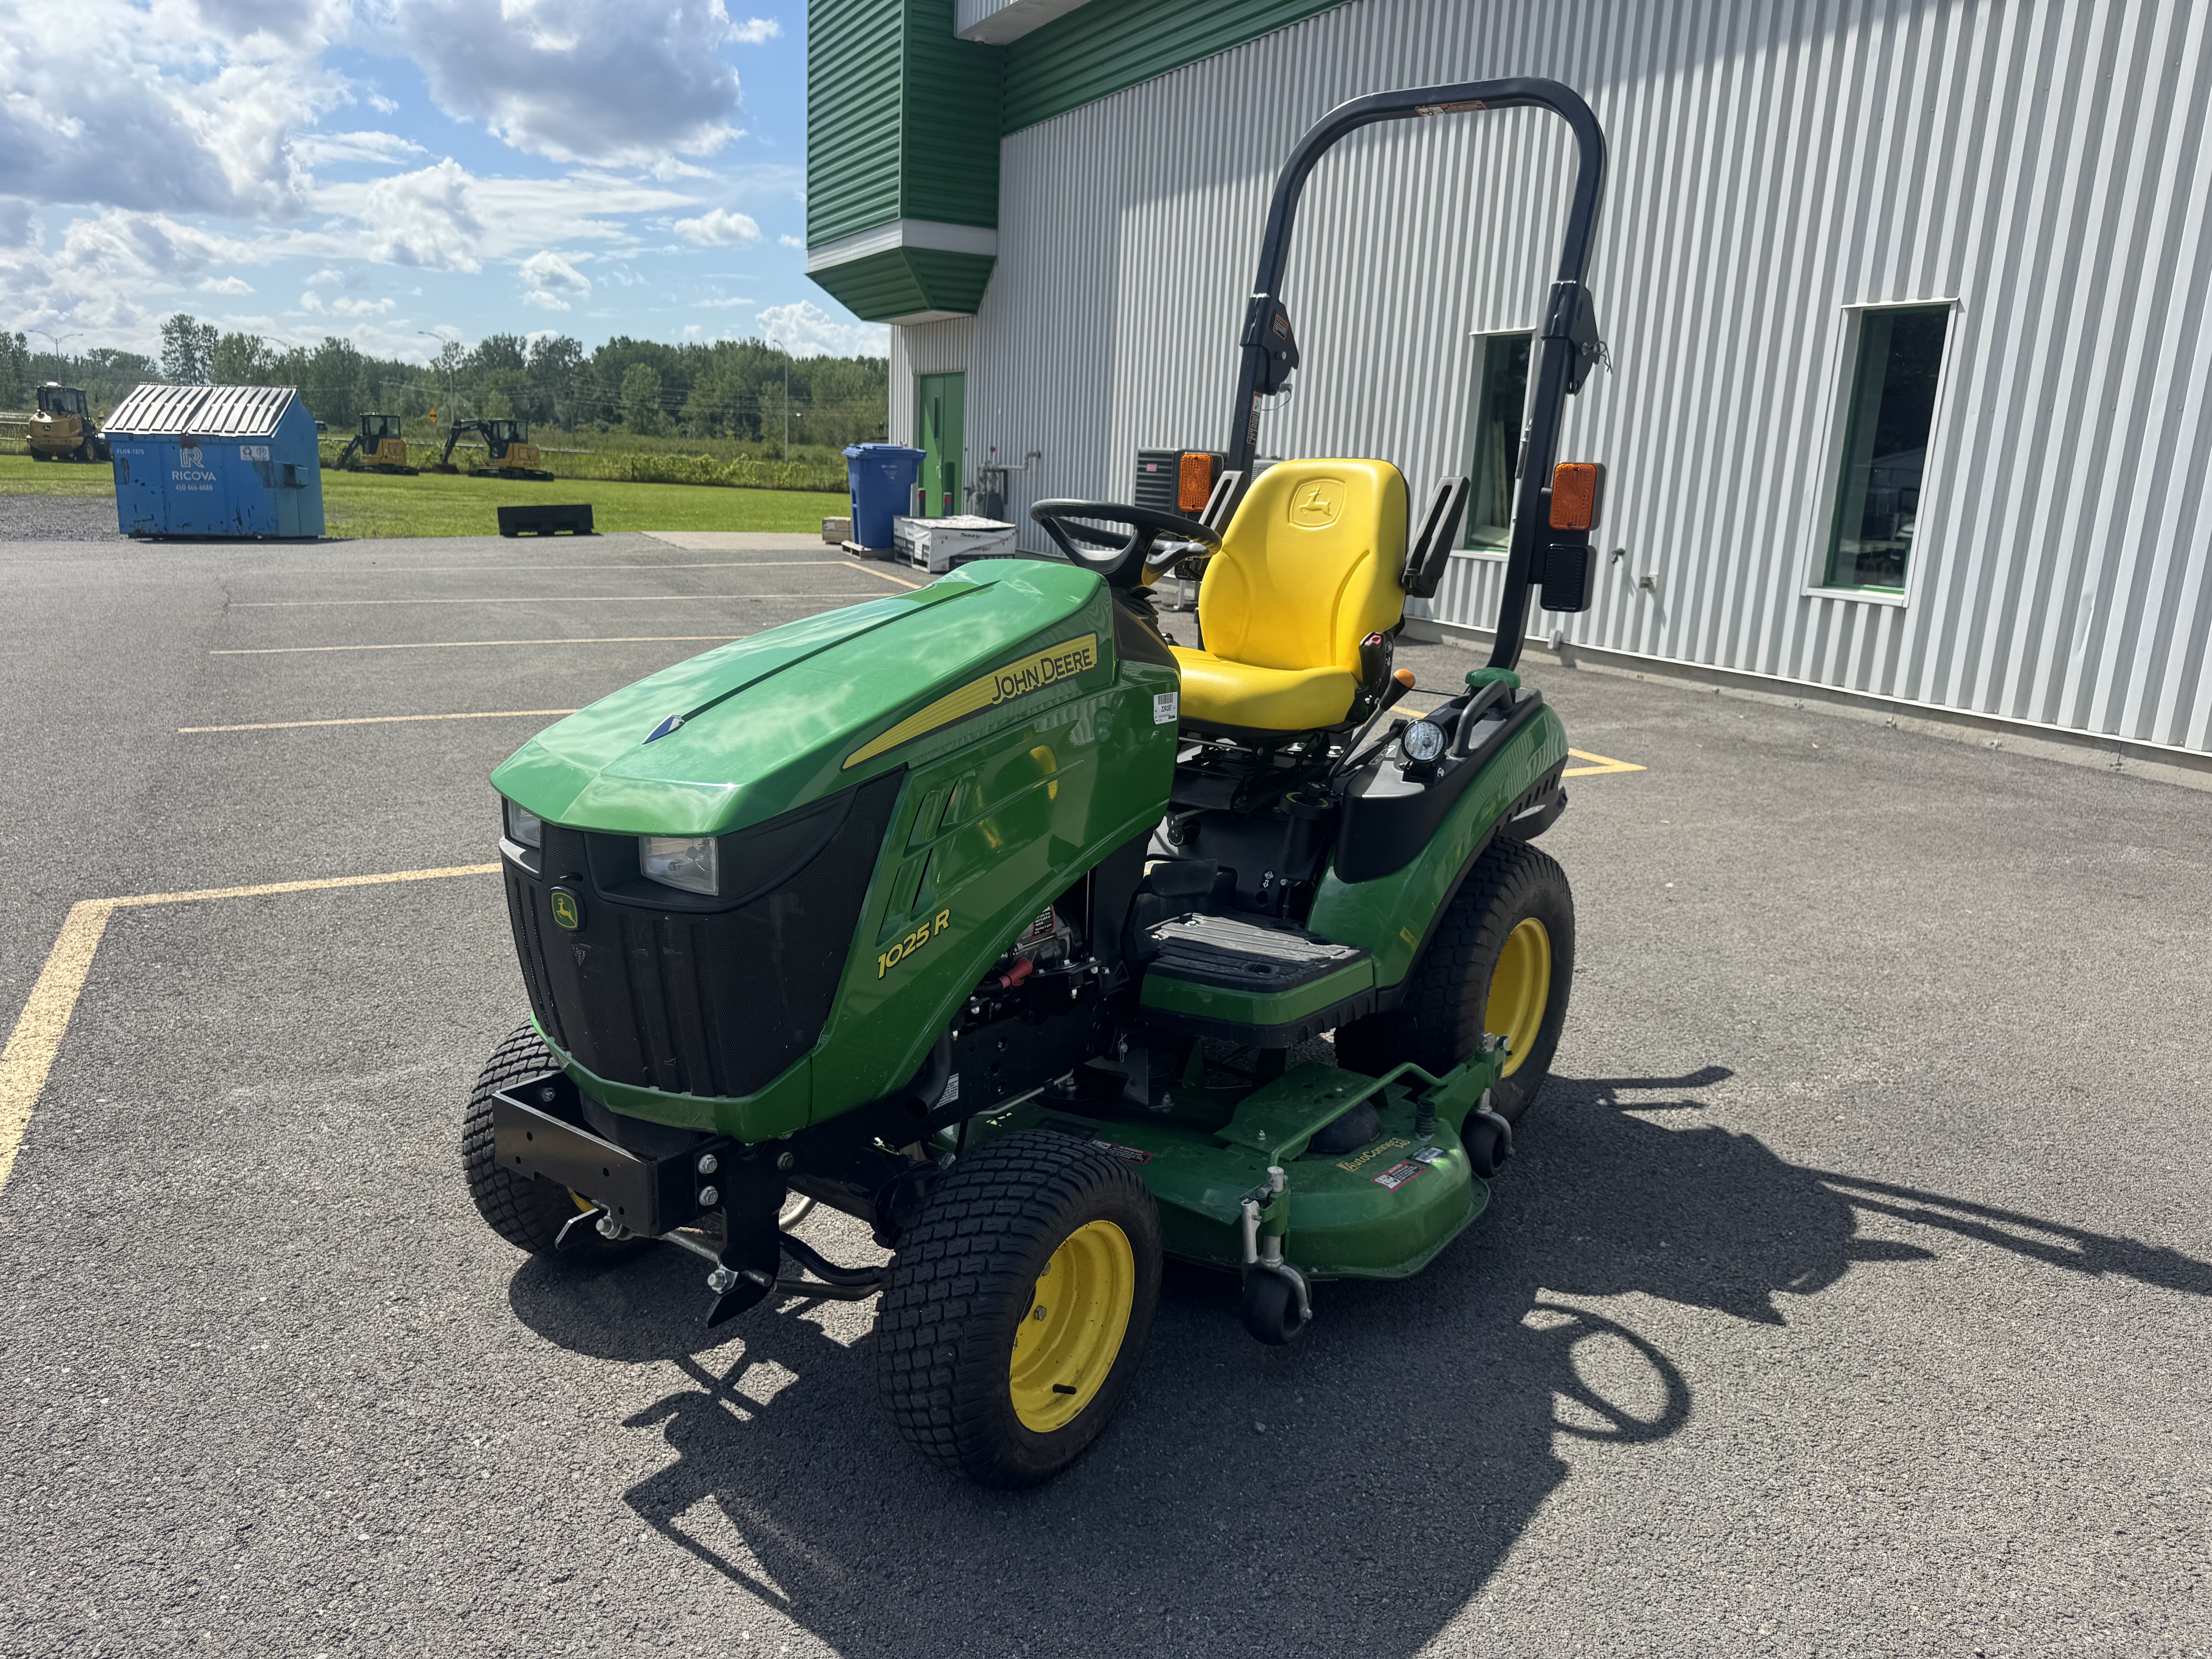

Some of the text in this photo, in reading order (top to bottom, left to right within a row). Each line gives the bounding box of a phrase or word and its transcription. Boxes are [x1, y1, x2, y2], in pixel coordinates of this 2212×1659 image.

[172, 471, 216, 481] RICOVA
[992, 647, 1093, 702] JOHN DEERE
[878, 908, 950, 979] 1025 R
[1343, 1137, 1403, 1171] AutoConnect
